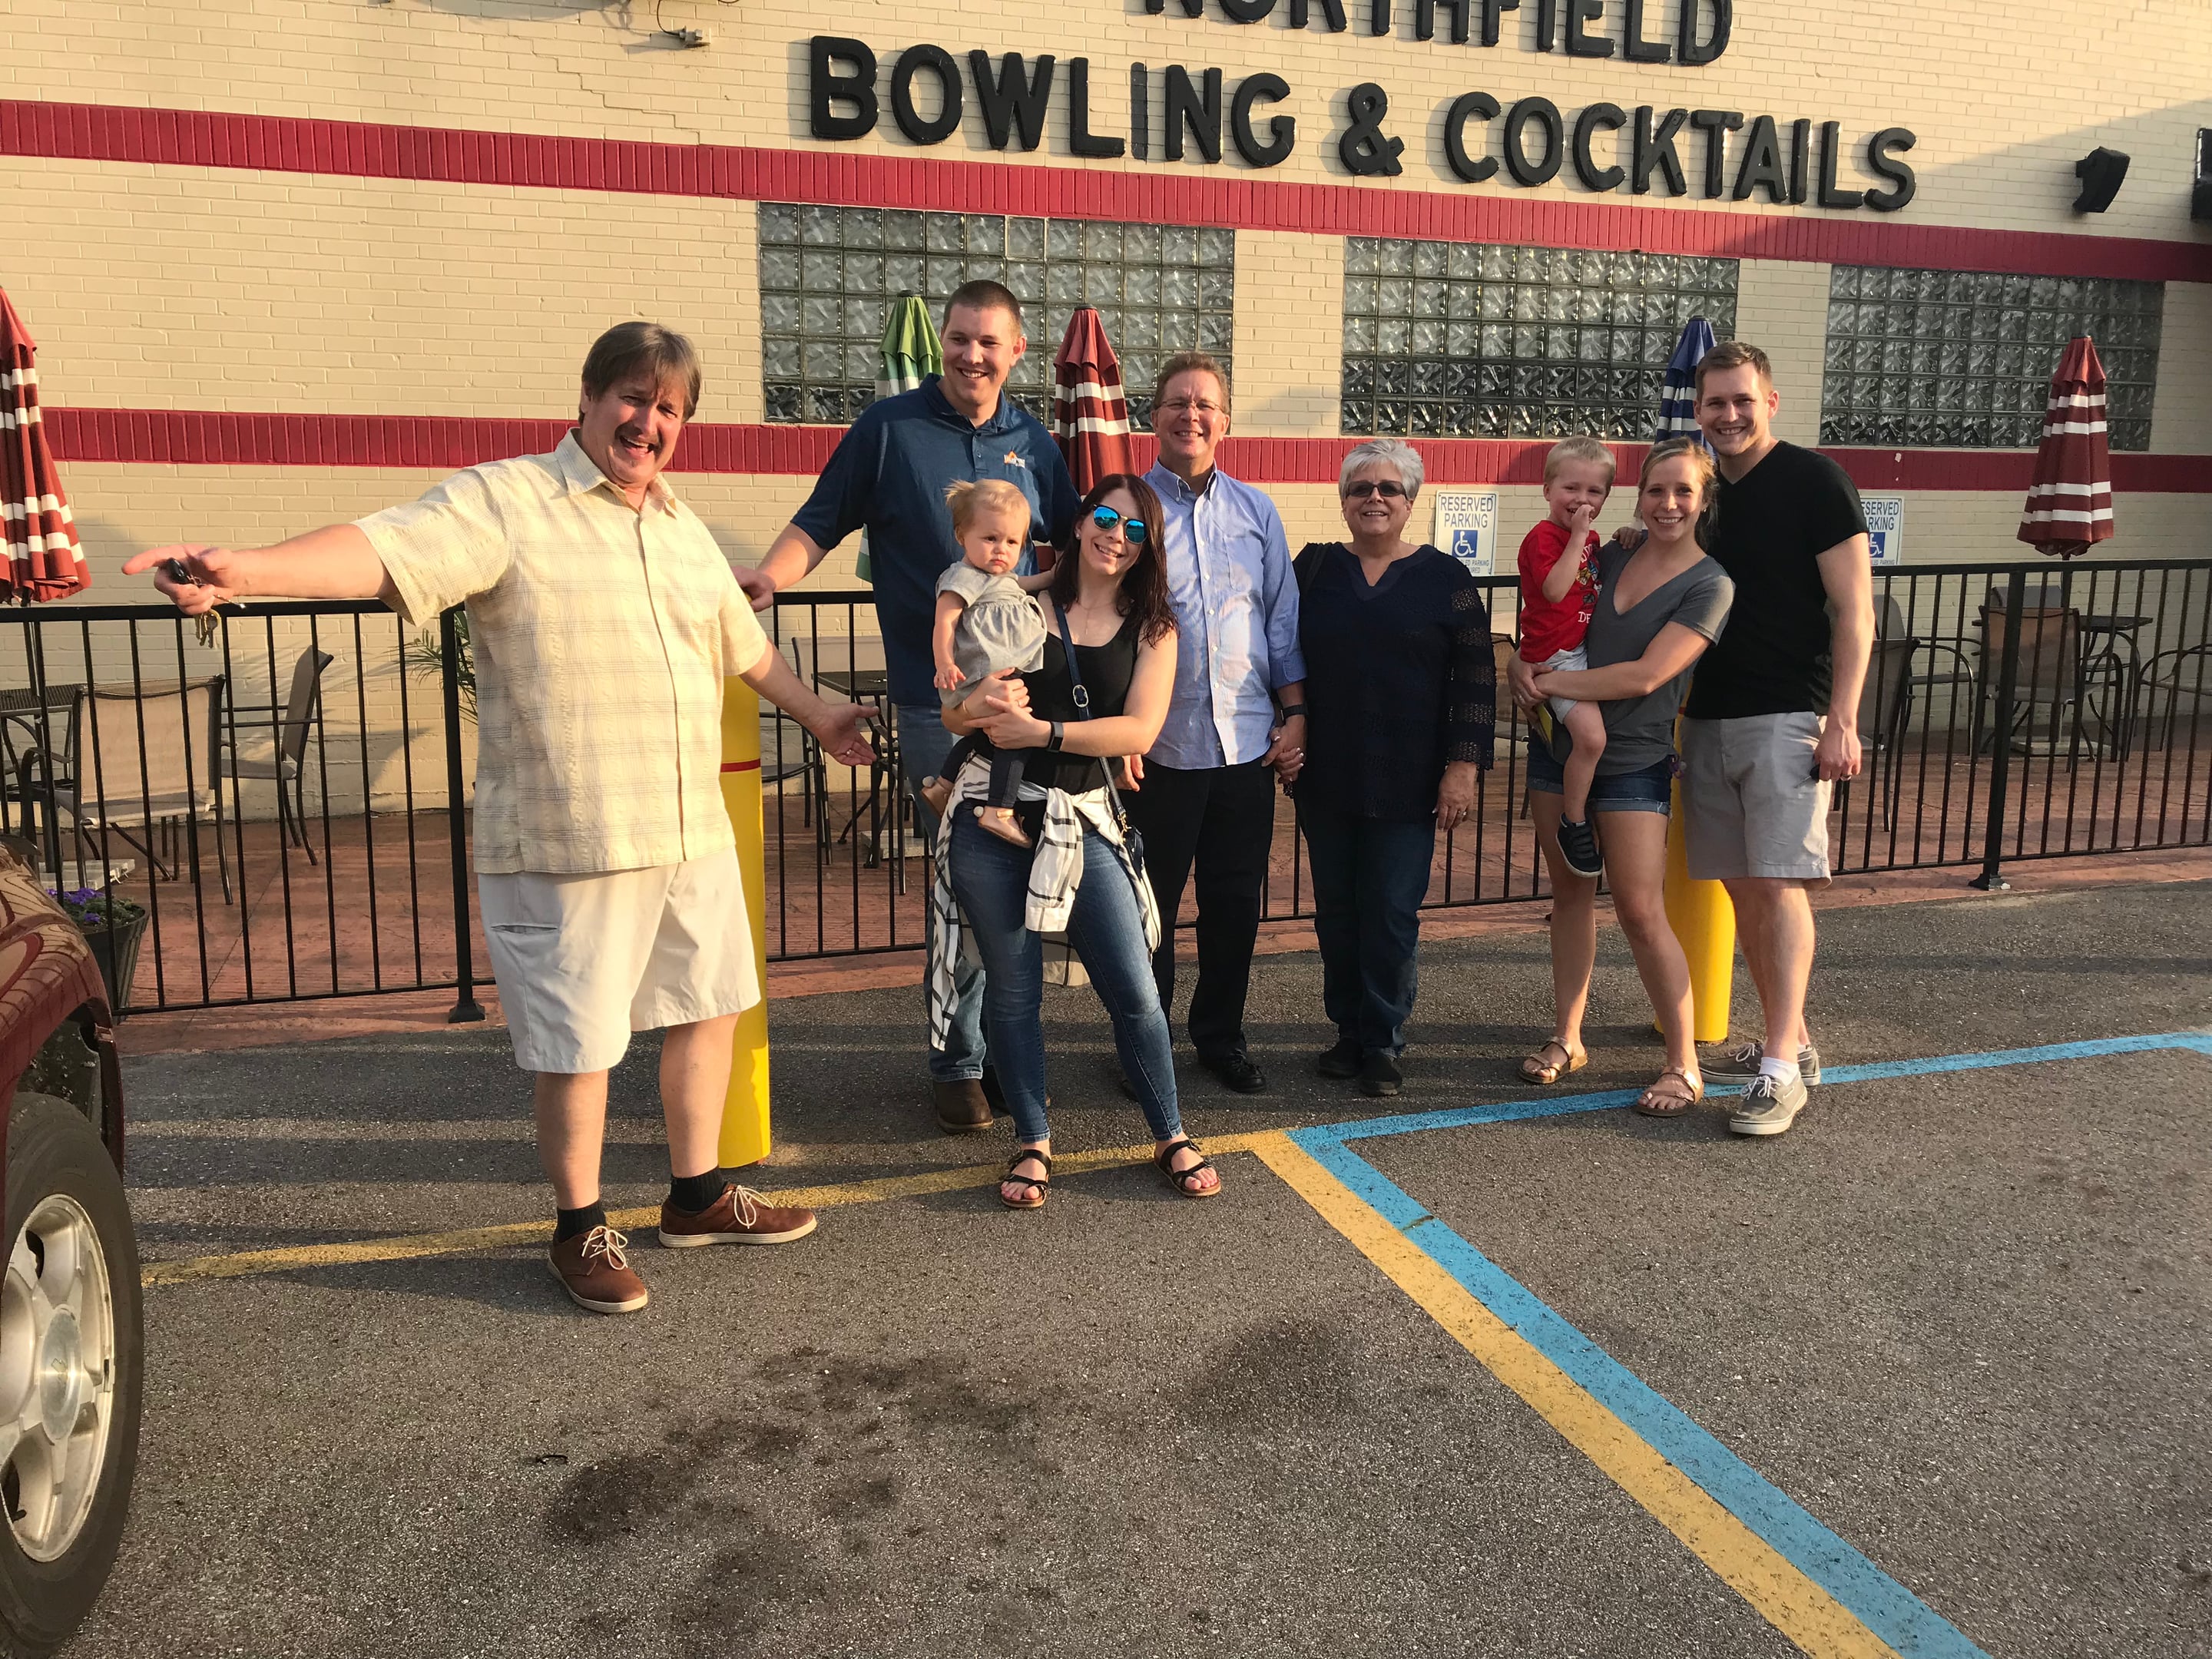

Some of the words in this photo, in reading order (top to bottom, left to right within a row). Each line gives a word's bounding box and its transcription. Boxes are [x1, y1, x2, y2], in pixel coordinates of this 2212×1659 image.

[1145, 0, 1732, 65] FIELD
[810, 35, 1296, 167] BOWLING
[1339, 82, 1405, 176] &
[1444, 91, 1916, 211] COCKTAILS
[1440, 496, 1494, 512] RESERVED
[1861, 502, 1899, 515] SERVED
[1444, 513, 1488, 528] PARKING
[1868, 516, 1895, 531] RKING
